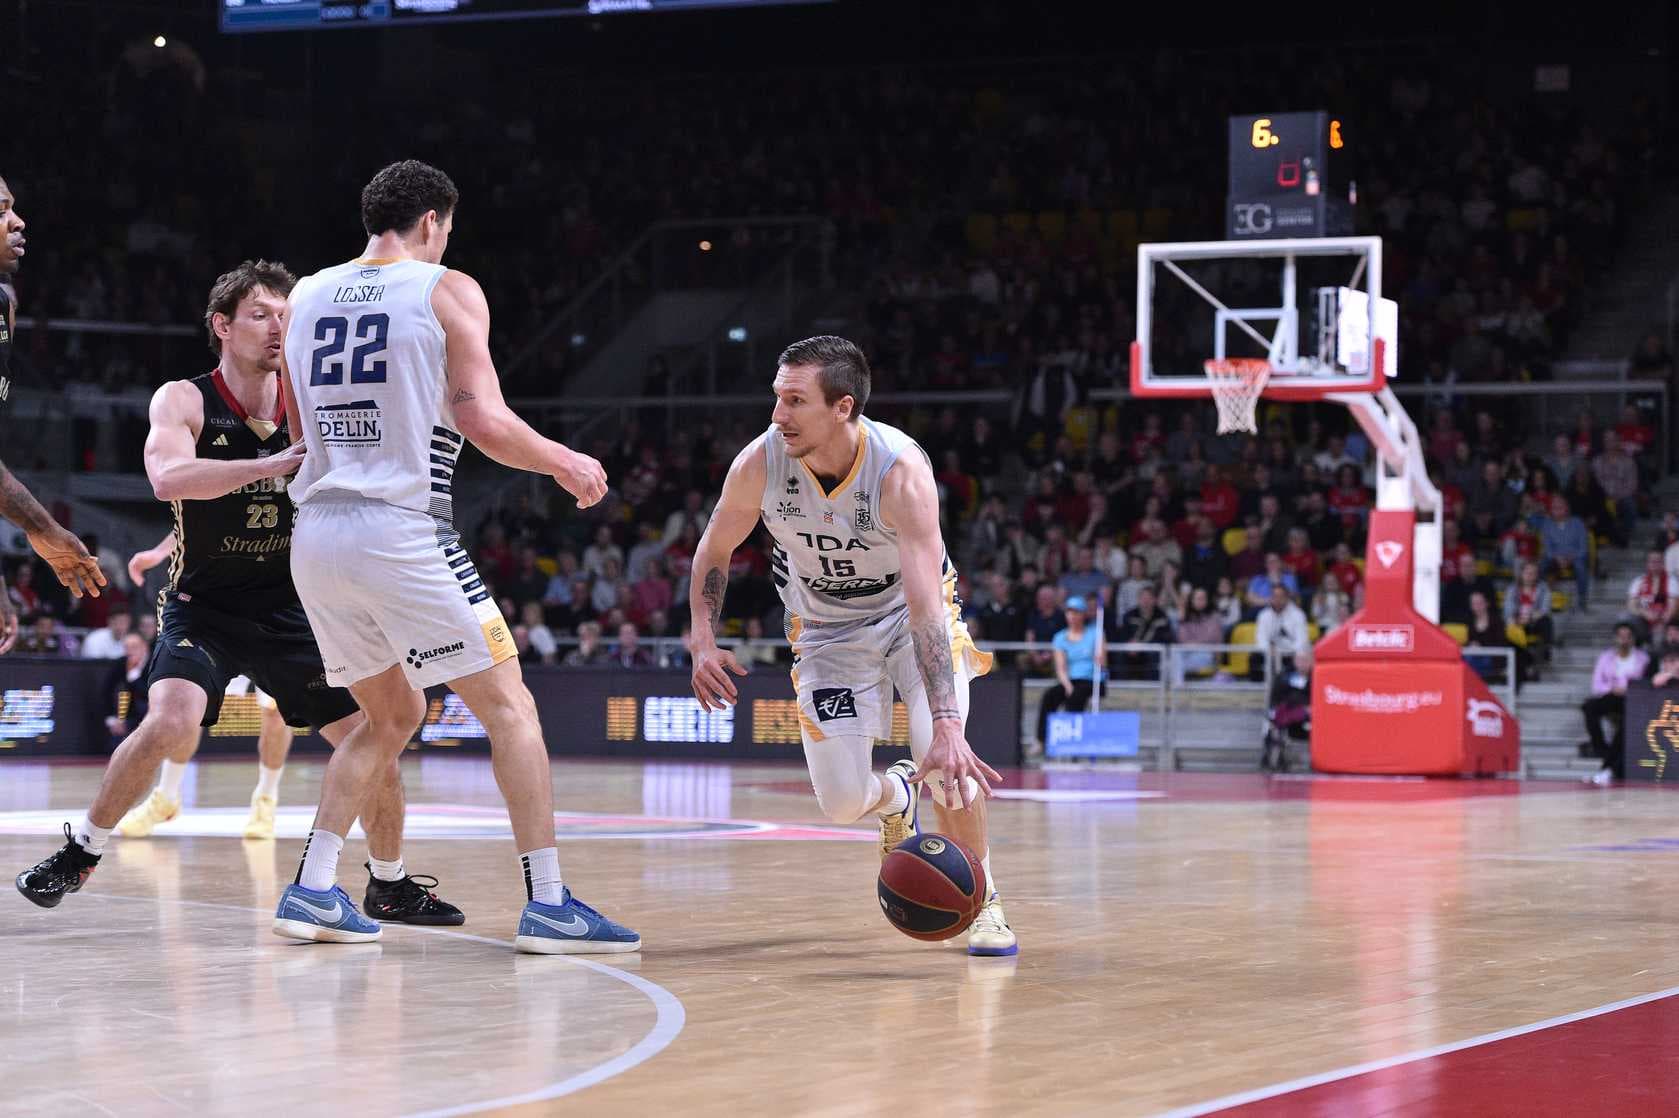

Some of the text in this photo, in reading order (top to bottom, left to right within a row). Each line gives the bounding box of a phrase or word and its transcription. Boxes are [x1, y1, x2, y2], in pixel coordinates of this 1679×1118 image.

[333, 284, 385, 303] LOSSER
[310, 313, 390, 387] 22
[318, 420, 377, 437] DELIN
[246, 503, 279, 528] 23
[819, 555, 856, 577] 15
[418, 641, 465, 661] SELFORME
